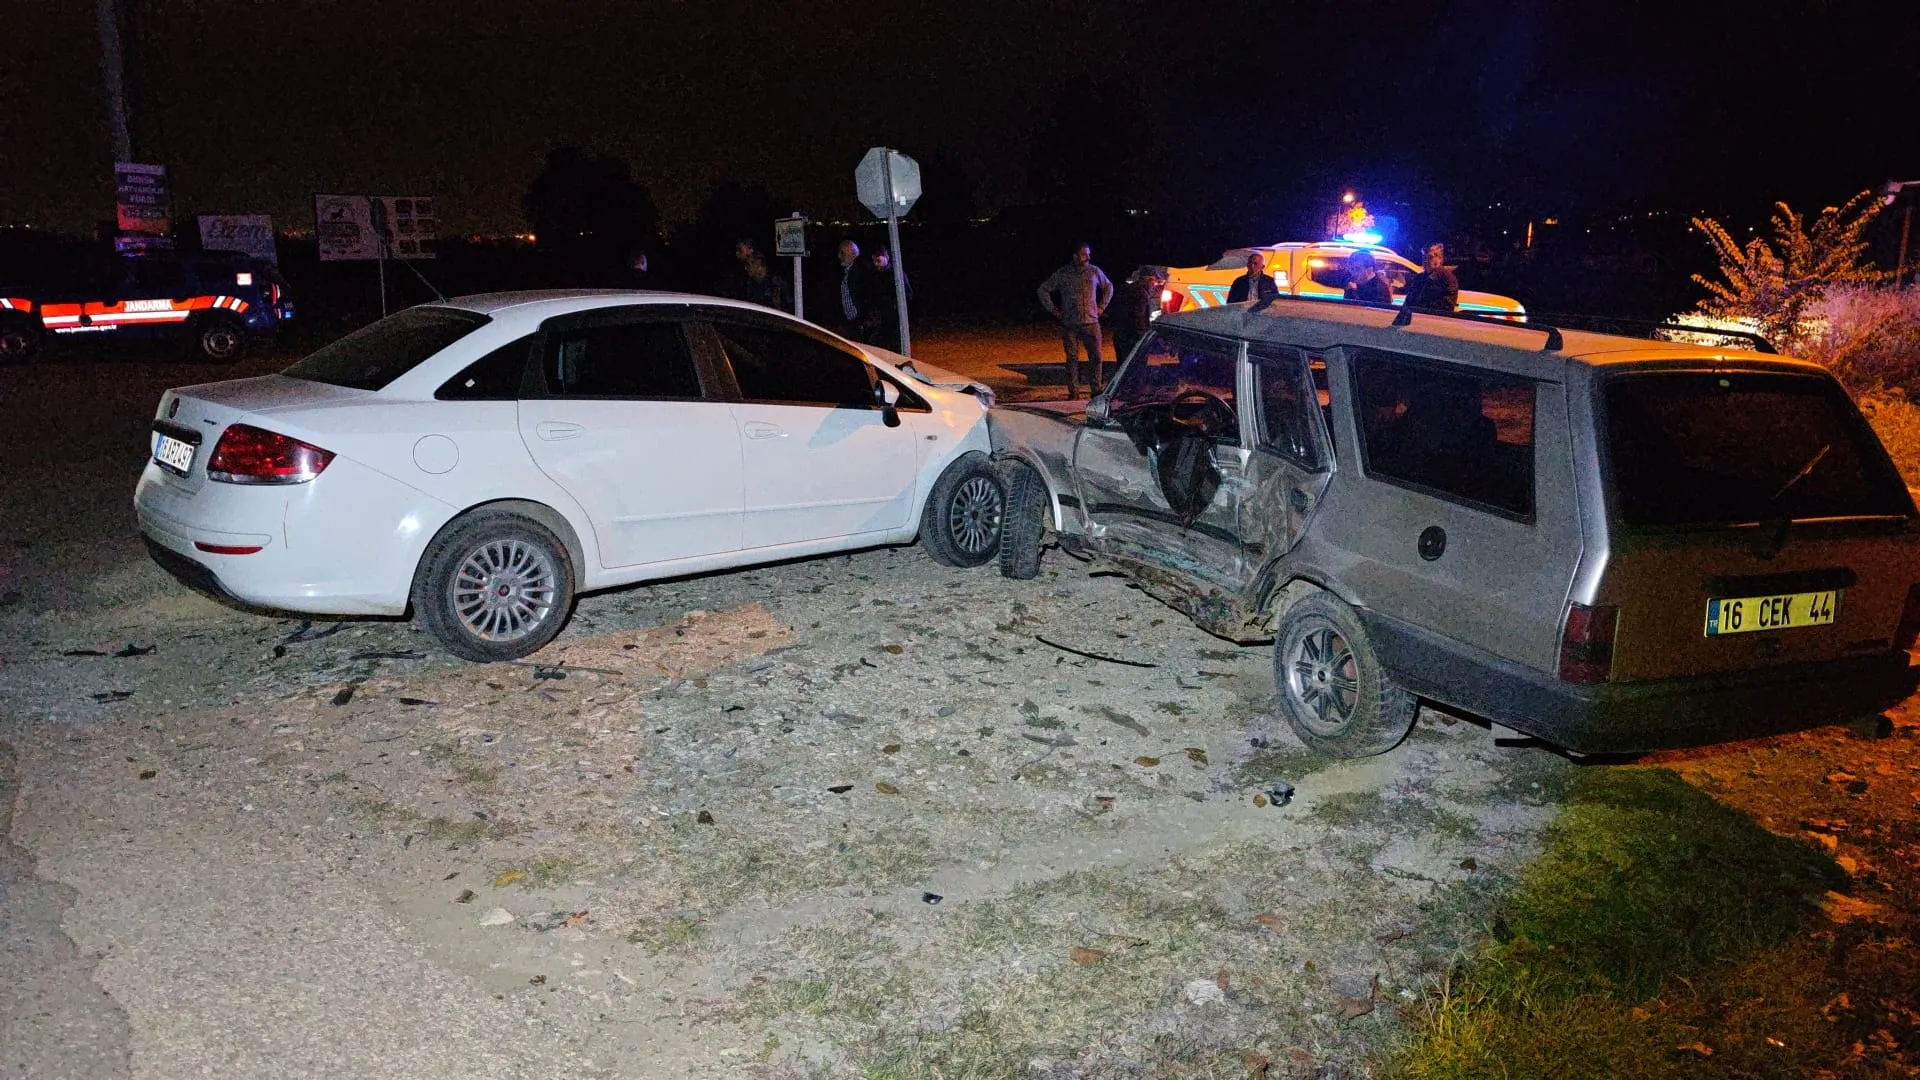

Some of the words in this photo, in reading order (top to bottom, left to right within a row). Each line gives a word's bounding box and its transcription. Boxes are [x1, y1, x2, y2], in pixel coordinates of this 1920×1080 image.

[124, 299, 173, 312] JANDARMA
[1723, 601, 1743, 630] 16
[1759, 597, 1793, 627] CEK
[1809, 593, 1830, 622] 44
